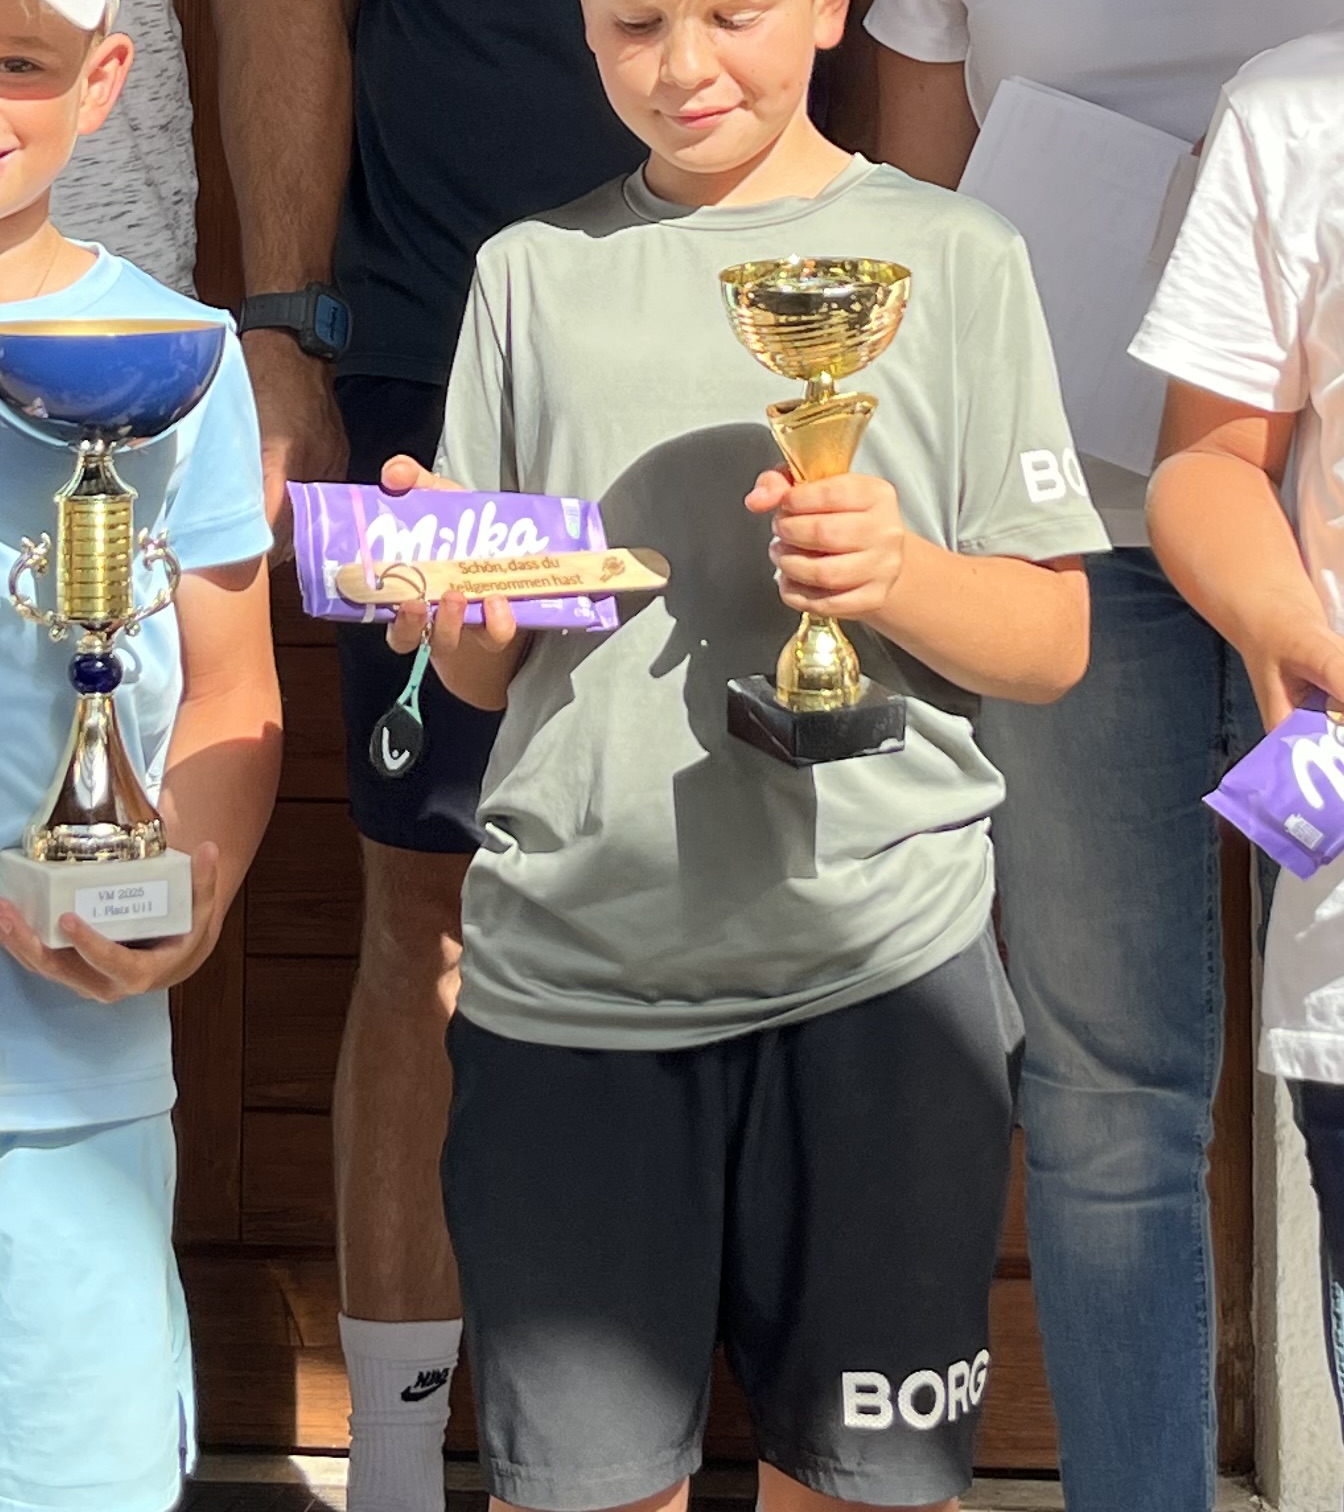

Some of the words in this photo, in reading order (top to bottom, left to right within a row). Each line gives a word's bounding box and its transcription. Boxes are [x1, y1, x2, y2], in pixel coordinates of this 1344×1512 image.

[509, 557, 539, 571] dass
[542, 556, 560, 569] du
[553, 574, 584, 586] hast
[841, 1348, 990, 1430] BORG
